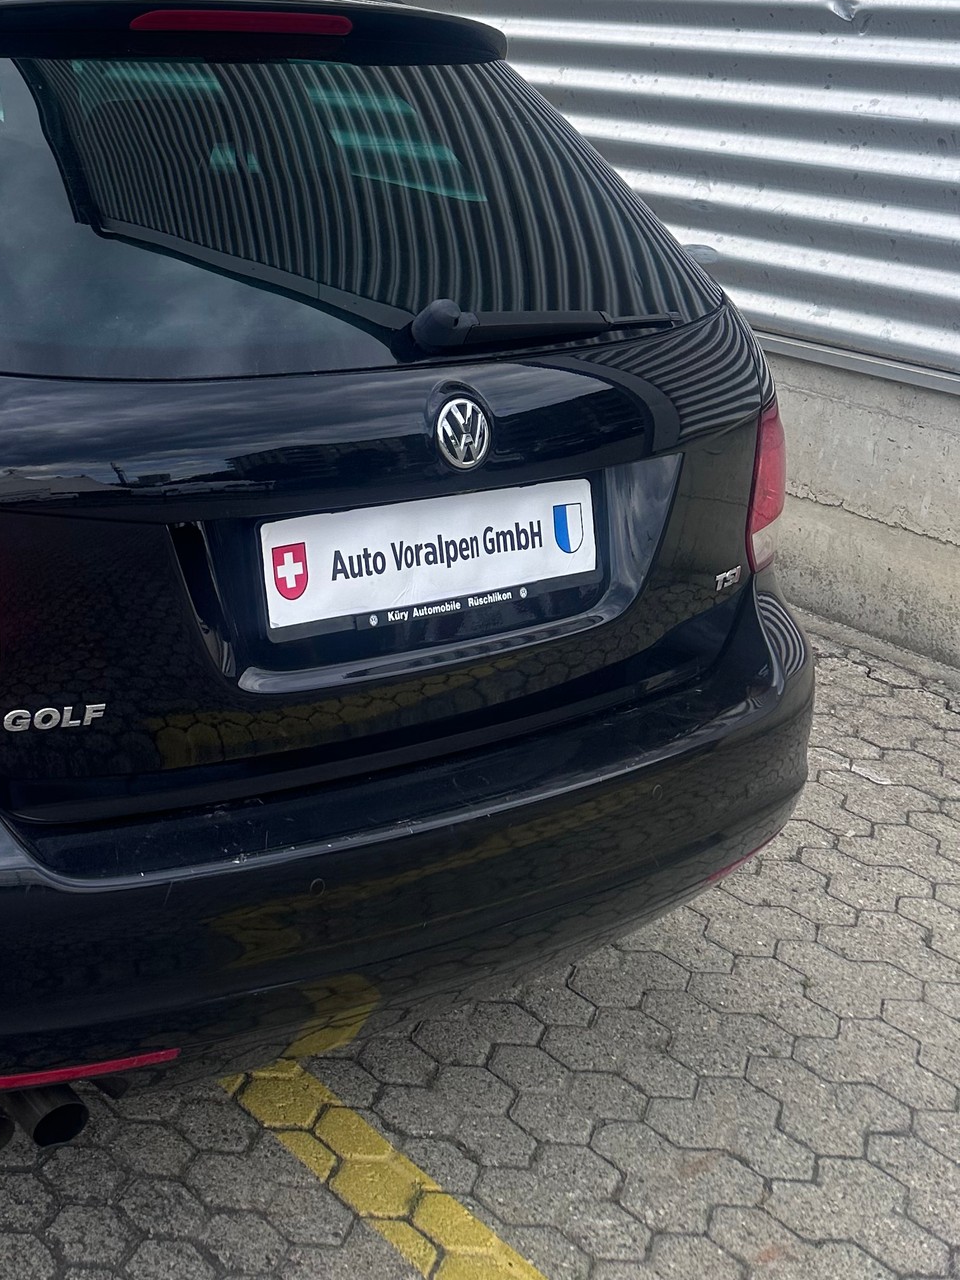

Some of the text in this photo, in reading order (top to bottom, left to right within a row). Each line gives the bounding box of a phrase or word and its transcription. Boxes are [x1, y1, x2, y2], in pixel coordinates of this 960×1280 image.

[331, 520, 543, 581] Auto Voralpen GmbH
[387, 610, 409, 622] Küry
[412, 600, 461, 618] Automobile
[467, 591, 513, 607] Rüschlikon
[3, 703, 106, 731] GOLF
